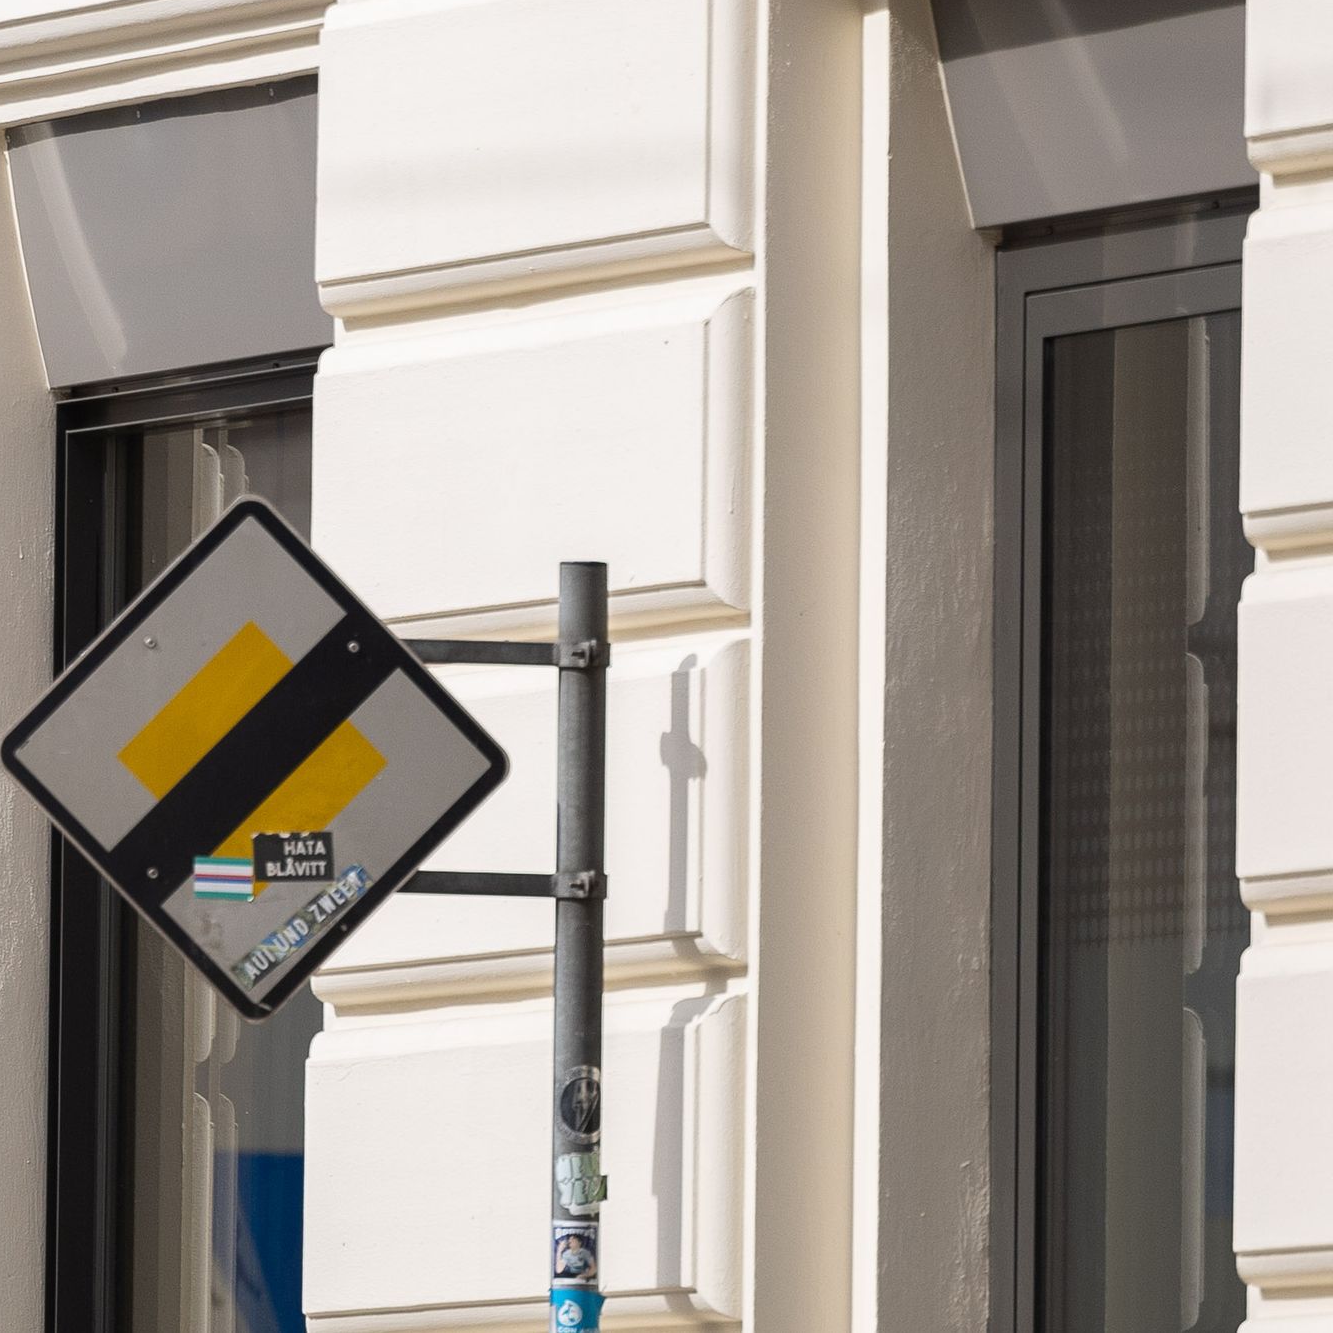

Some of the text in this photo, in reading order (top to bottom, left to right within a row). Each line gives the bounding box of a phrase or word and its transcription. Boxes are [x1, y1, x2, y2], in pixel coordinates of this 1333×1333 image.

[284, 840, 326, 856] HATA
[265, 857, 328, 878] BLÅVITT
[272, 918, 310, 953] UND
